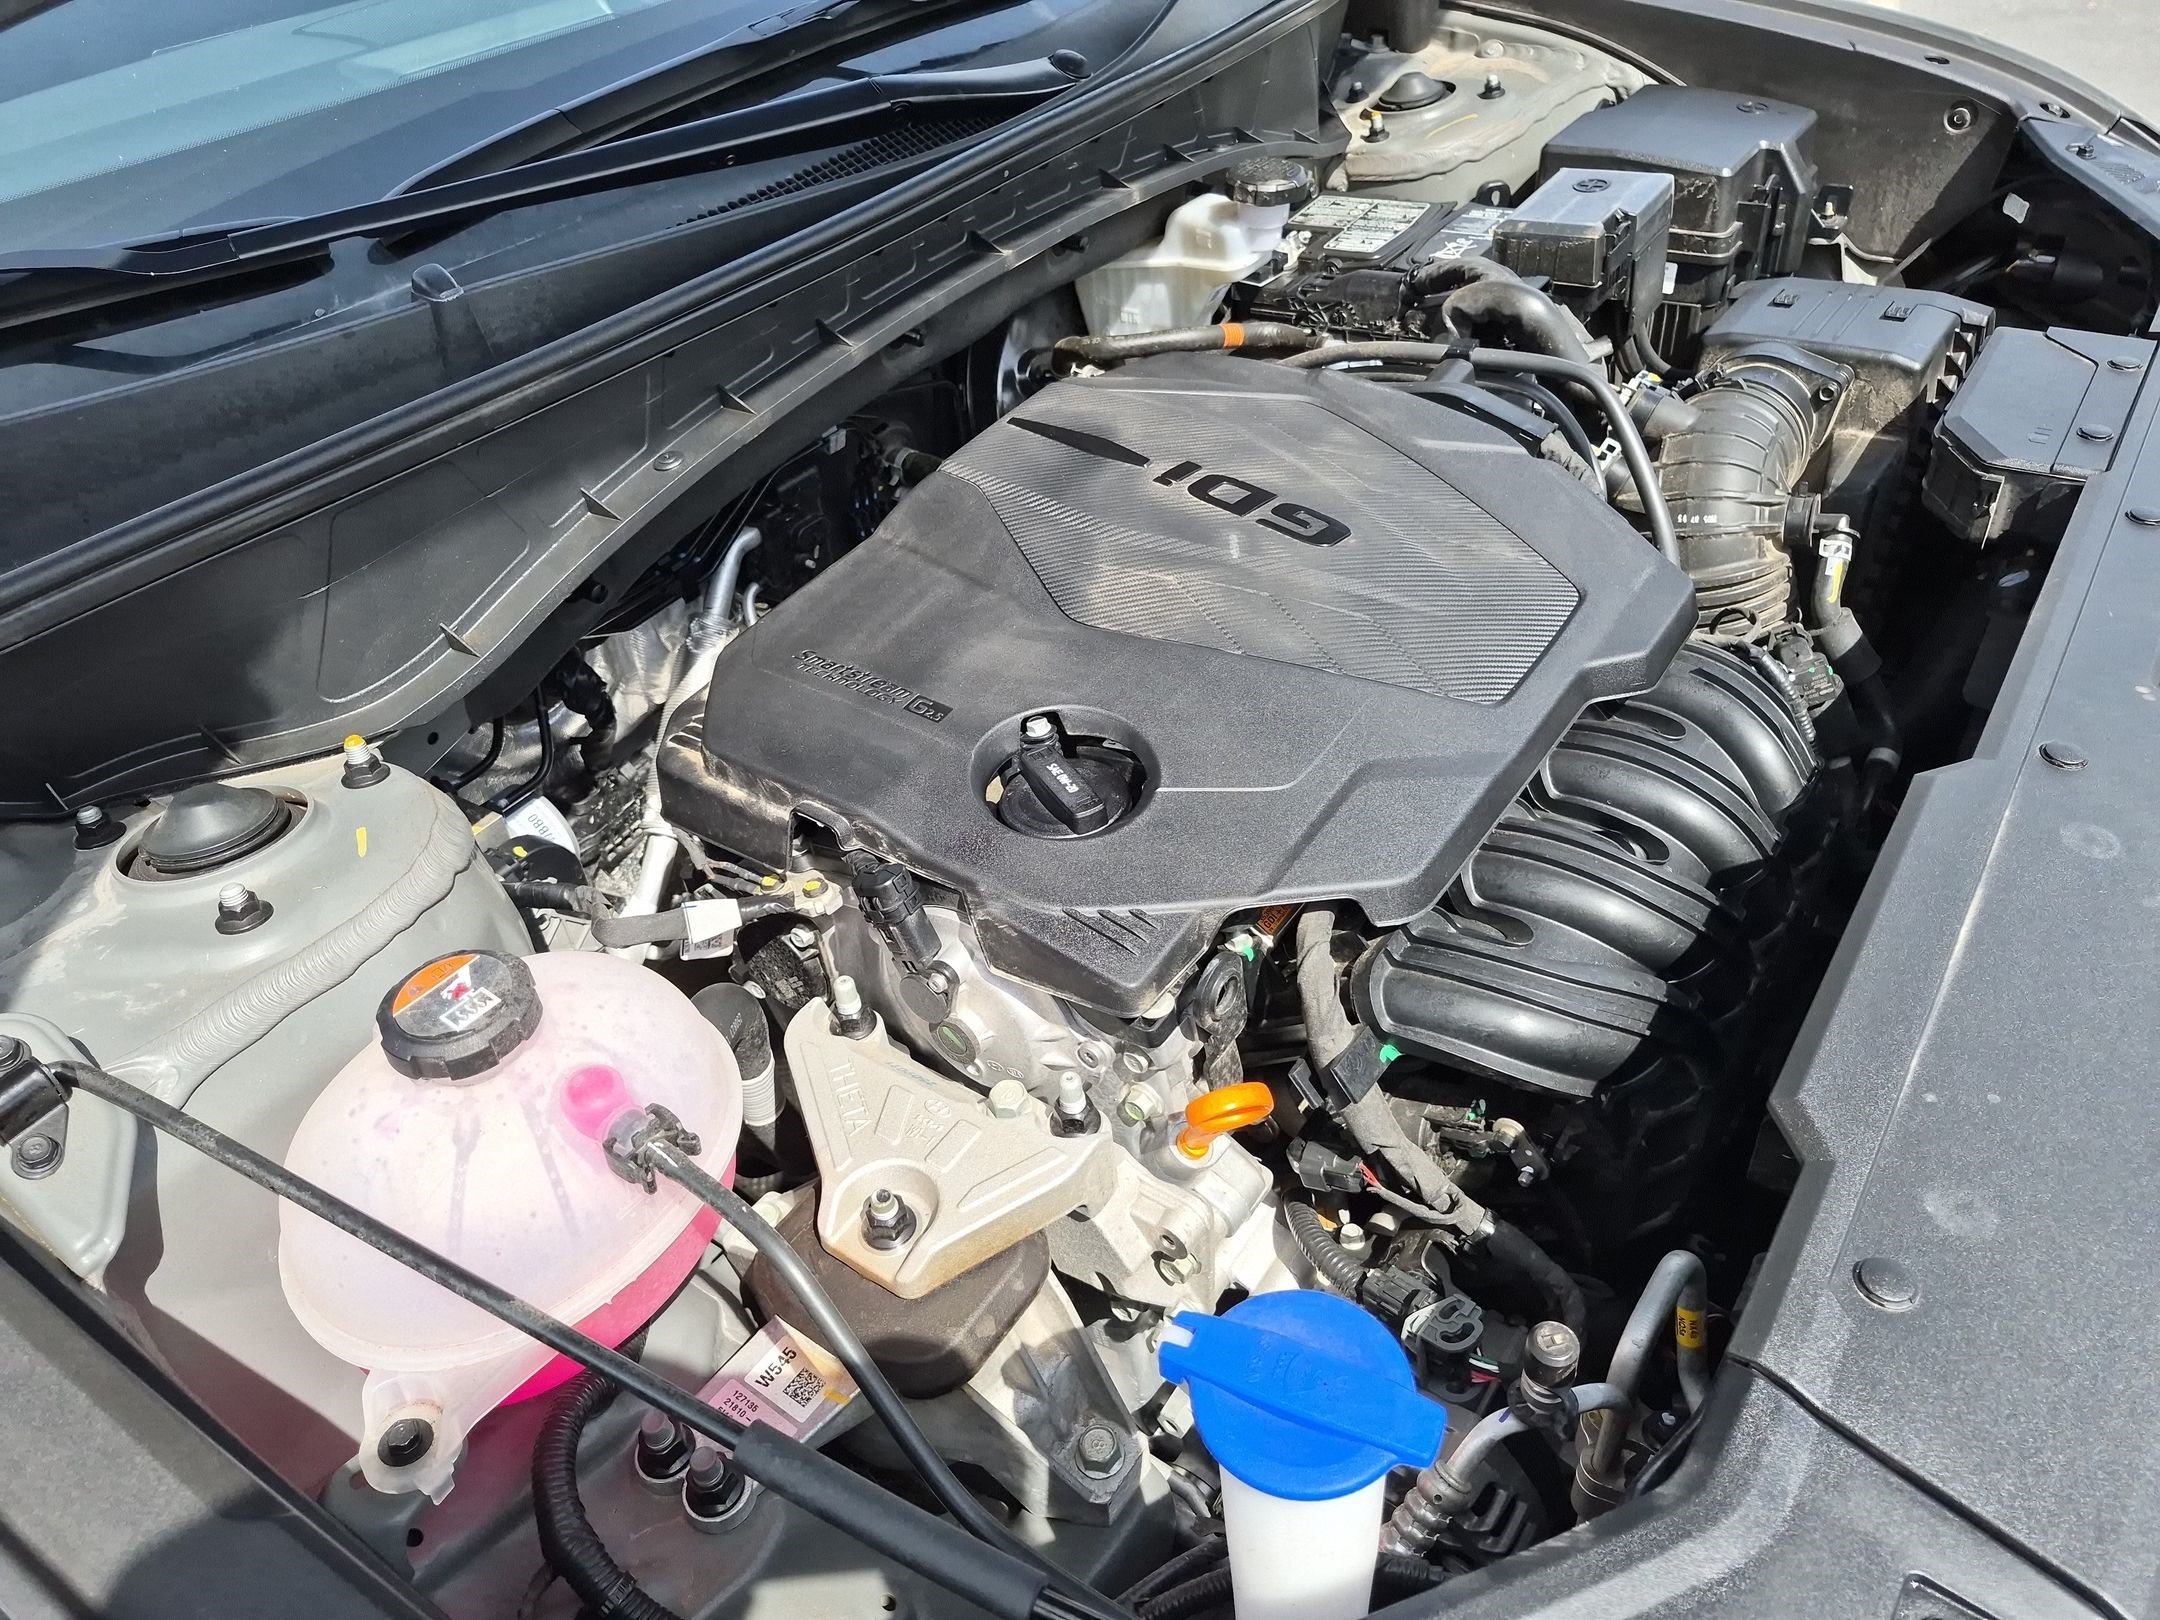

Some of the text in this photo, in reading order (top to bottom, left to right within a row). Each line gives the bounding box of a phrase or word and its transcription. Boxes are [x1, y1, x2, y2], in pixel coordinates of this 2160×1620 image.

[792, 650, 913, 698] Smartstream
[1046, 763, 1063, 777] SAE
[829, 1057, 872, 1136] THETA
[754, 1347, 797, 1388] W545
[732, 1390, 759, 1413] 127135
